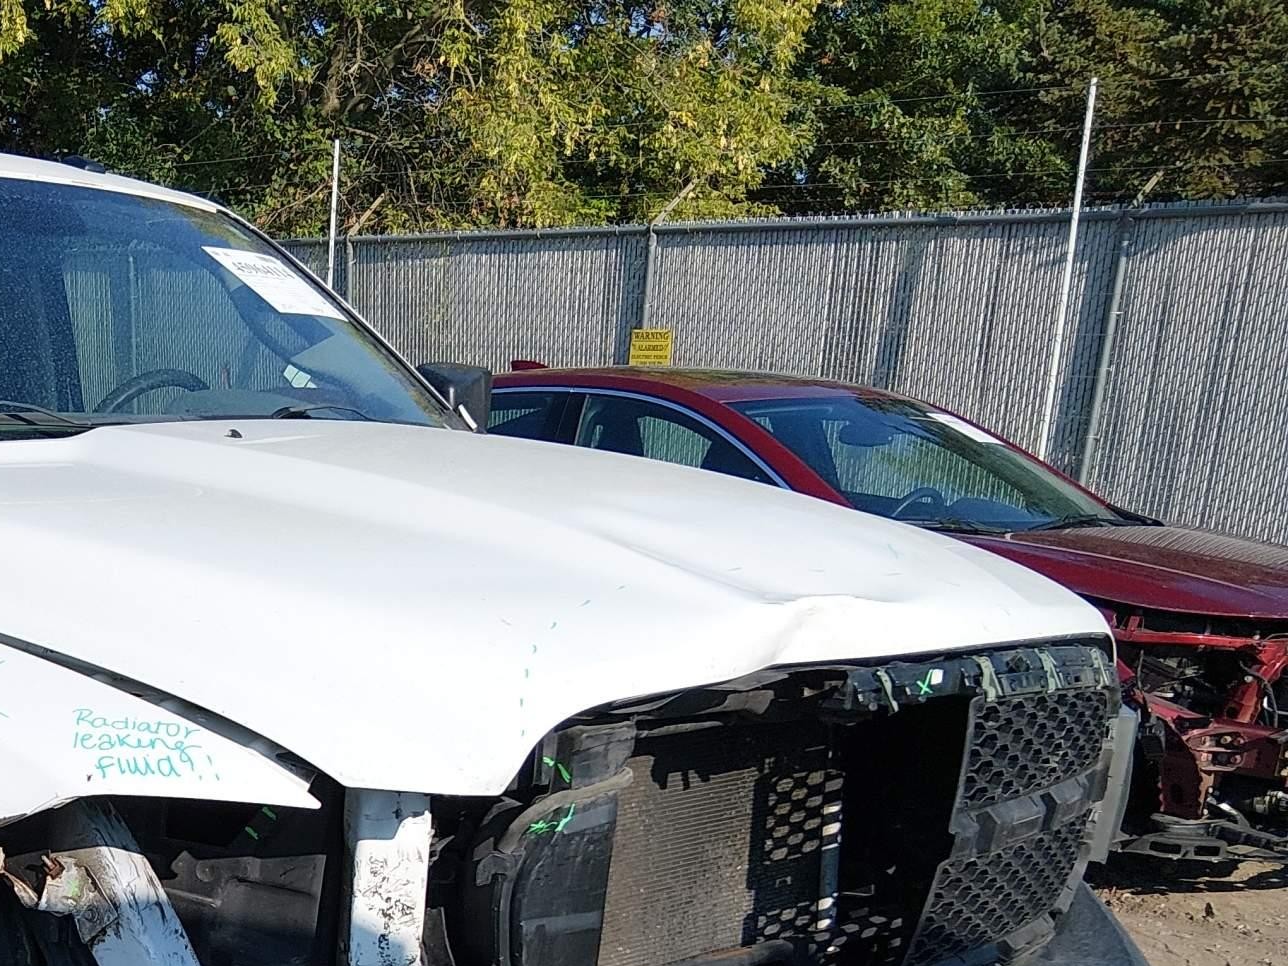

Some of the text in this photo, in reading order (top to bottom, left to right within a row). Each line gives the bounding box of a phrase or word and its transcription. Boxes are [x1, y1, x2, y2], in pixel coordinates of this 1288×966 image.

[634, 332, 669, 341] WARNING
[72, 708, 201, 739] Radiator
[72, 731, 202, 771] leaking
